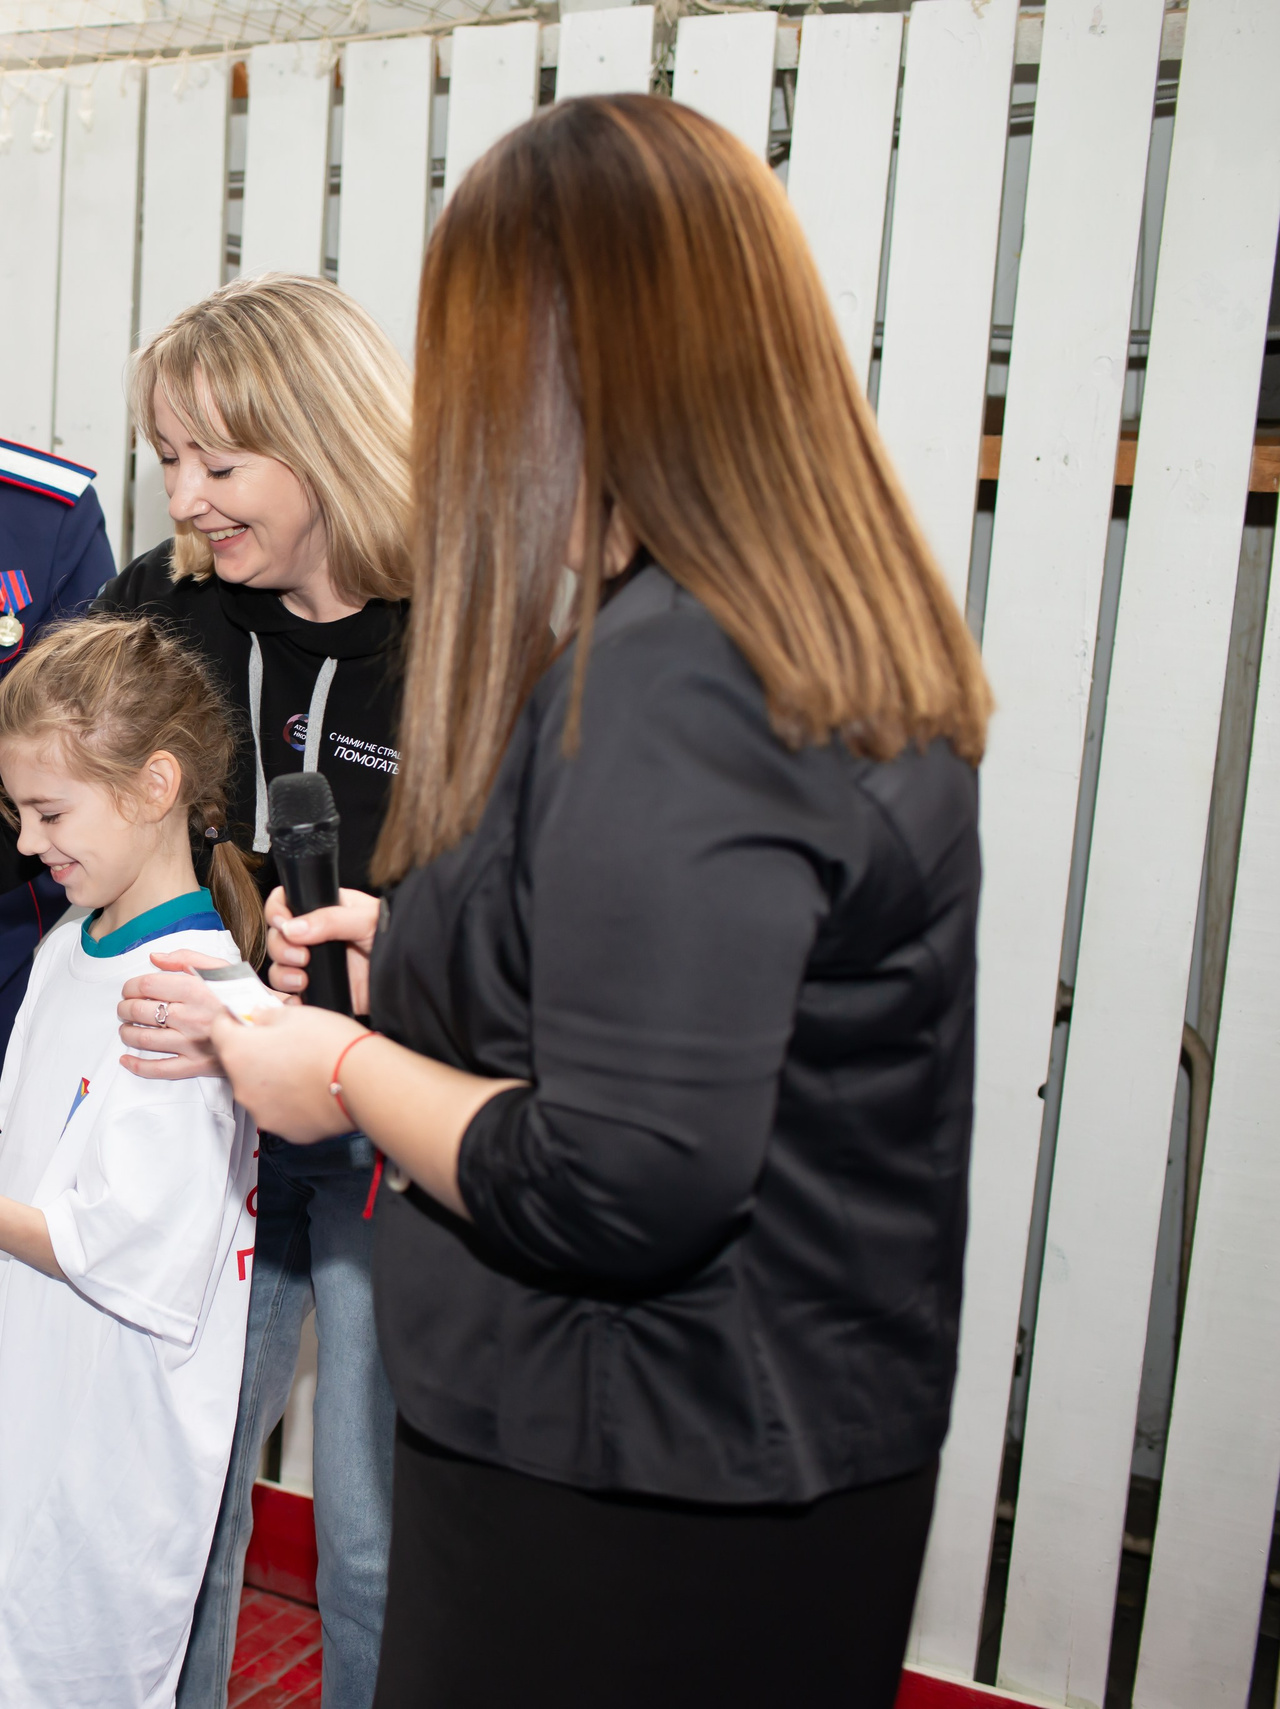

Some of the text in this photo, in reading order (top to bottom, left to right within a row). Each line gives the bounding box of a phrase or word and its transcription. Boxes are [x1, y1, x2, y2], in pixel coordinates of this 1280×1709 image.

[329, 732, 337, 741] С
[337, 734, 364, 748] НАМИ
[364, 743, 378, 753] НЕ
[333, 746, 400, 775] ПОМОГАТЬ
